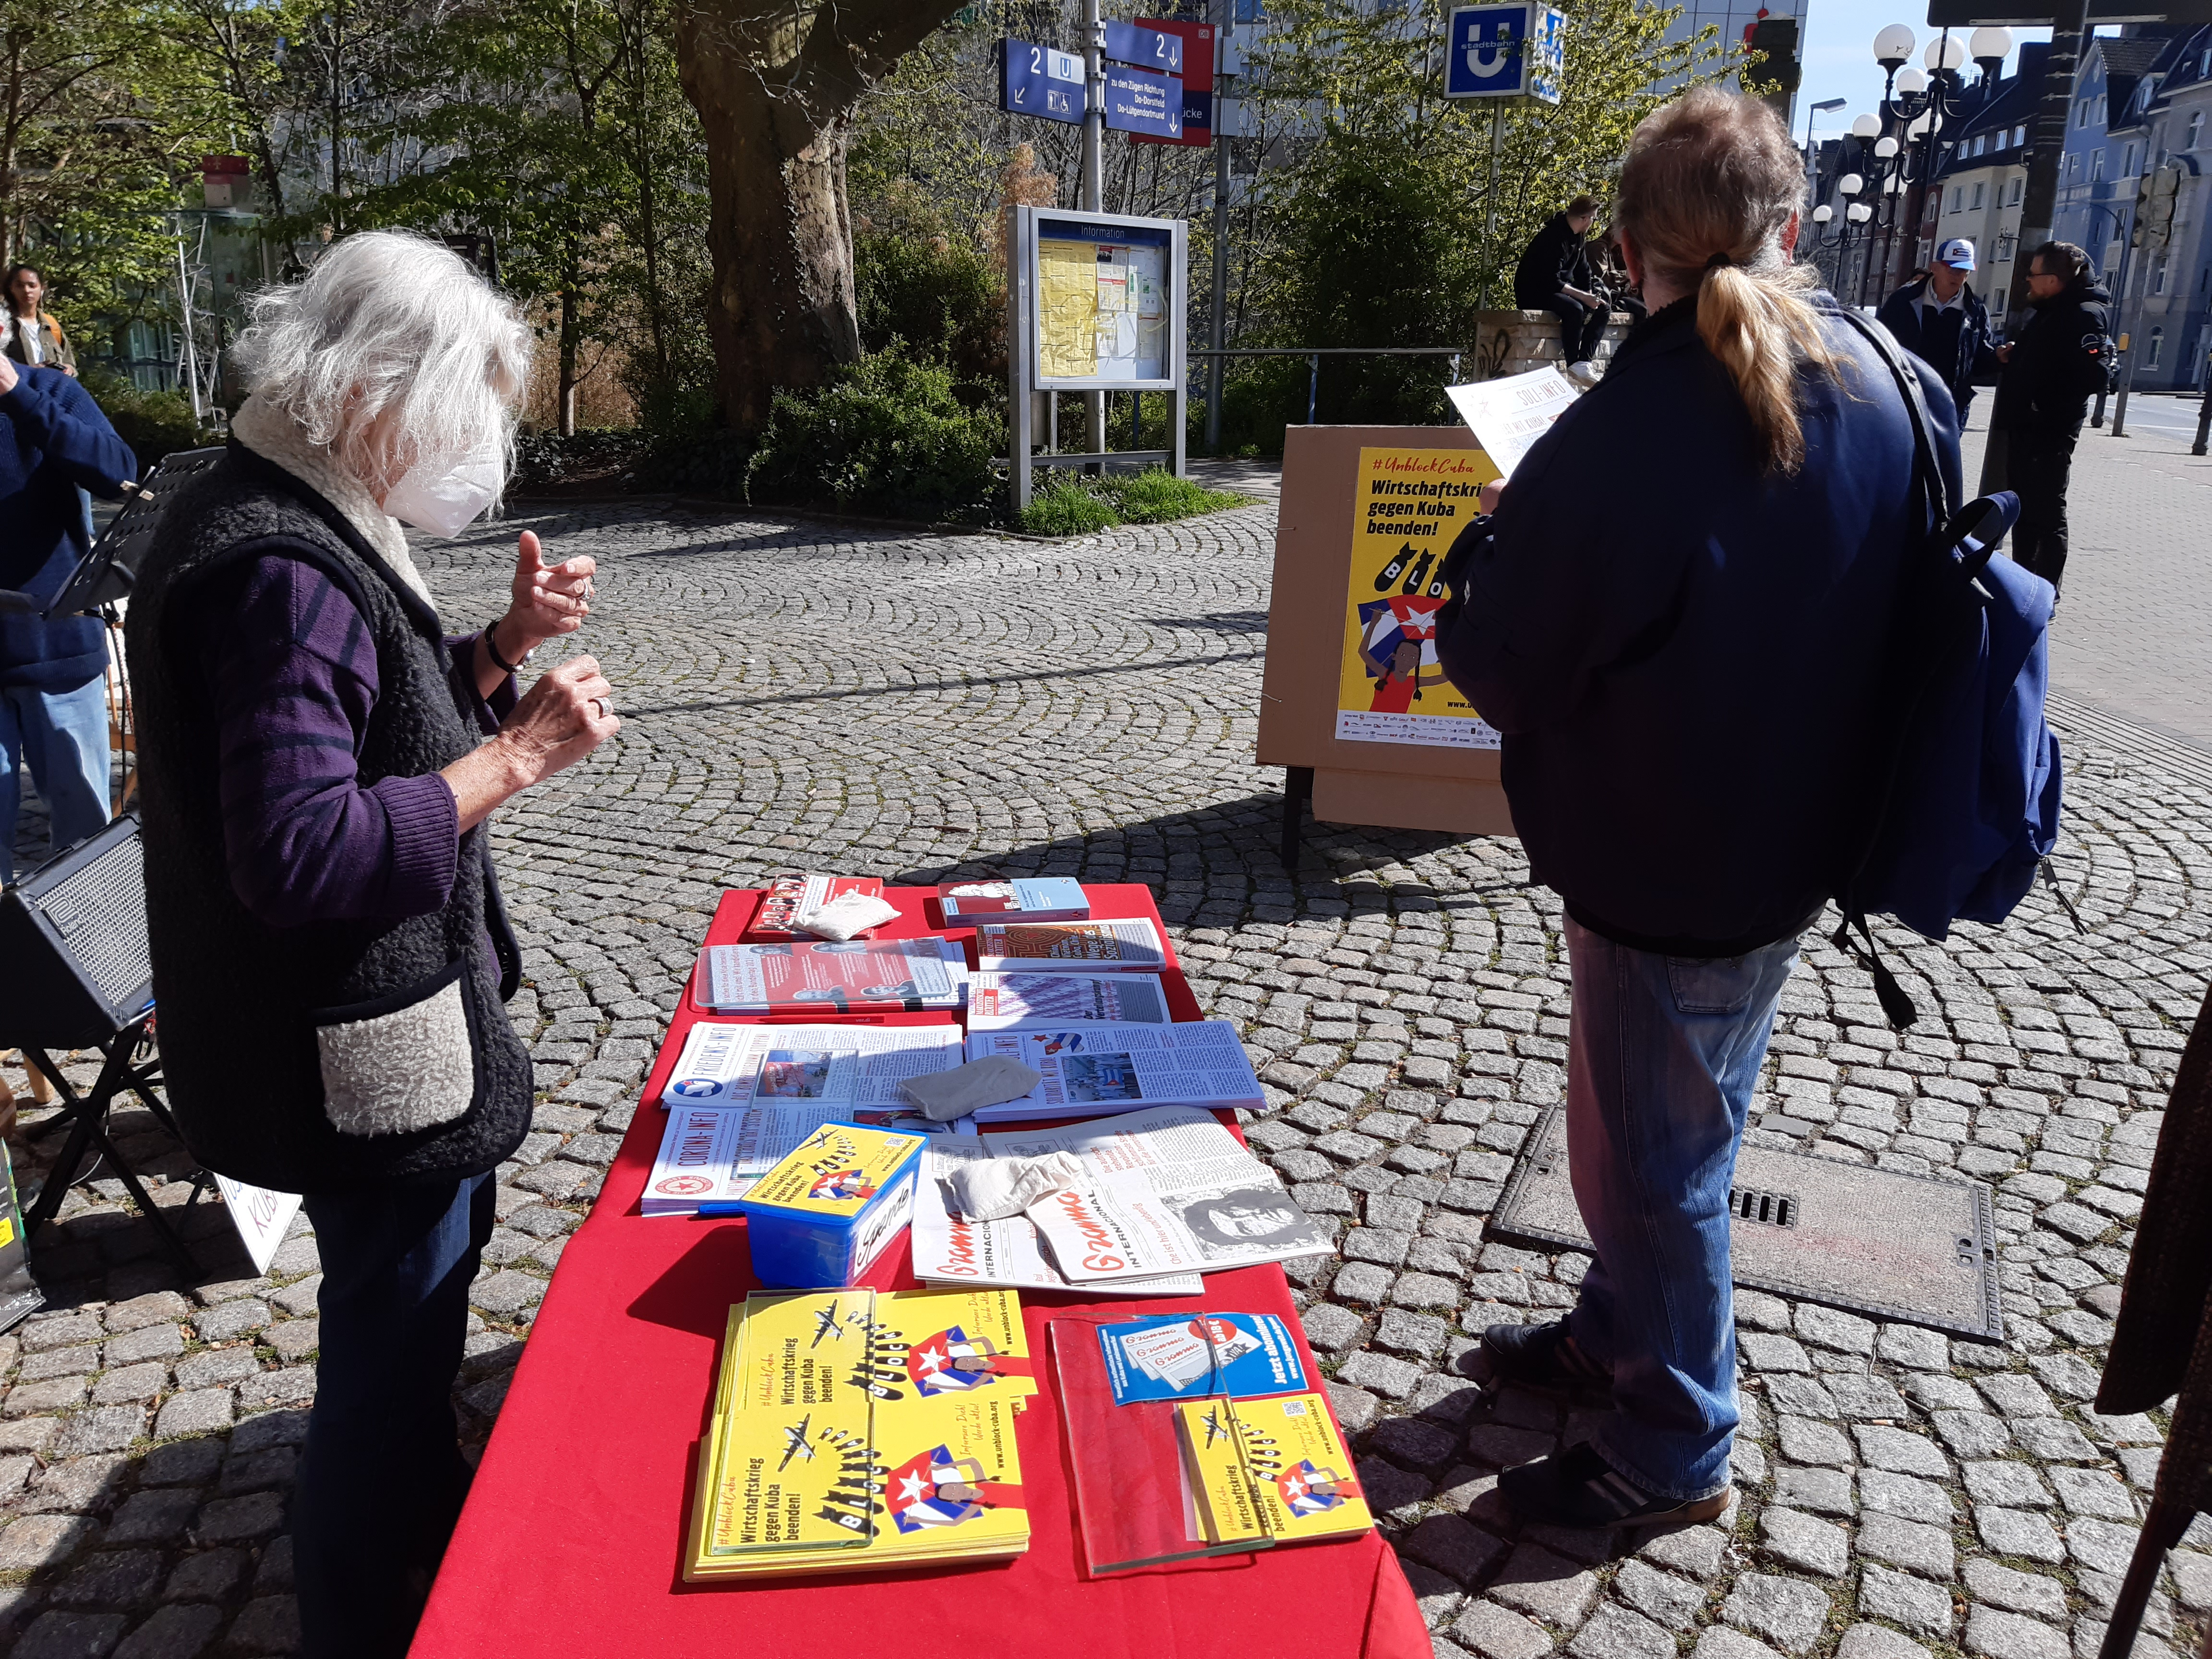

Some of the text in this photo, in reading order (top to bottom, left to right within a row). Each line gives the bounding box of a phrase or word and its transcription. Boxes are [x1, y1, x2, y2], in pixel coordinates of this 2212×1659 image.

[1156, 34, 1165, 58] 2
[1461, 40, 1515, 50] stadtbahn
[1031, 47, 1041, 74] 2
[1061, 58, 1070, 77] U
[1118, 79, 1128, 88] den
[1129, 80, 1143, 92] Zügen
[1144, 83, 1166, 96] Richtung
[1118, 103, 1166, 120] Do-Lütgendortmund
[1135, 94, 1166, 108] Do-Dorstfeld
[1081, 226, 1125, 239] Information
[1516, 380, 1566, 406] SOLI-INFO
[1524, 415, 1547, 429] KUBA!
[1372, 457, 1475, 474] #UnblockCuba
[1371, 480, 1486, 499] Wirtschaftskri
[1367, 501, 1455, 517] gegen Kuba
[1366, 518, 1439, 536] beenden!
[994, 938, 1005, 957] BLÄTTER
[1082, 930, 1103, 959] Wege des
[1099, 925, 1118, 960] Sozialismus
[975, 988, 984, 1015] MARXISTISCHE
[984, 996, 995, 1015] BLÄTTER
[1090, 979, 1106, 1020] Verteilungskampf
[692, 1027, 737, 1076] FRIEDENS-INFO
[749, 1034, 771, 1052] STOPPEN!
[994, 1036, 1021, 1060] LI-INFO
[735, 1054, 762, 1090] BOMBERPROGRAMM
[1039, 1057, 1058, 1069] KUBA!
[730, 1092, 750, 1100] DAS
[1041, 1078, 1065, 1105] SOLIDARITÄT
[677, 1112, 719, 1166] CORONA-INFO
[1114, 1130, 1146, 1167] schlimmste Strafe
[1125, 1129, 1157, 1166] für die Terroristen
[1090, 1146, 1114, 1174] Die aufrecht
[1105, 1149, 1125, 1171] stehende
[1114, 1144, 1135, 1169] Revolution
[725, 1179, 750, 1195] PANDEM
[758, 1161, 805, 1200] Wirtschaftskrieg
[771, 1174, 803, 1203] gegen Kuba
[781, 1180, 810, 1203] beenden!
[1132, 1202, 1154, 1222] lebendig
[1151, 1218, 1162, 1229] und
[856, 1187, 910, 1267] Spende
[1088, 1189, 1142, 1268] INTERNACIONAL
[1157, 1228, 1169, 1243] hier
[1162, 1242, 1174, 1253] ist
[1171, 1251, 1182, 1264] Che
[1125, 1329, 1177, 1344] Granma
[1211, 1325, 1223, 1334] 18
[1214, 1333, 1227, 1342] ab
[1136, 1337, 1185, 1357] Granma
[1154, 1343, 1200, 1366] Granma
[1228, 1344, 1243, 1358] ¡YA!
[1249, 1315, 1288, 1384] Jetzt abonnieren!
[780, 1337, 798, 1406] Wirtschaftskrieg
[1116, 1361, 1124, 1370] und
[1118, 1369, 1127, 1380] Kuba
[759, 1352, 775, 1407] #UnblockCuba
[800, 1358, 817, 1405] gegen Kuba
[818, 1365, 833, 1403] beenden!
[956, 1404, 972, 1455] Informiere Dich!
[974, 1422, 985, 1441] Werde
[989, 1400, 1005, 1469] www.unblock-cuba.org
[1307, 1399, 1334, 1455] www.unblock-cuba.org
[740, 1457, 765, 1544] Wirtschaftskrieg
[1225, 1465, 1254, 1530] Wirtschaftskrieg
[718, 1476, 736, 1545] #UnblockCuba
[764, 1483, 781, 1543] gegen Kuba
[782, 1493, 801, 1541] beenden!
[1262, 1495, 1286, 1532] beenden!
